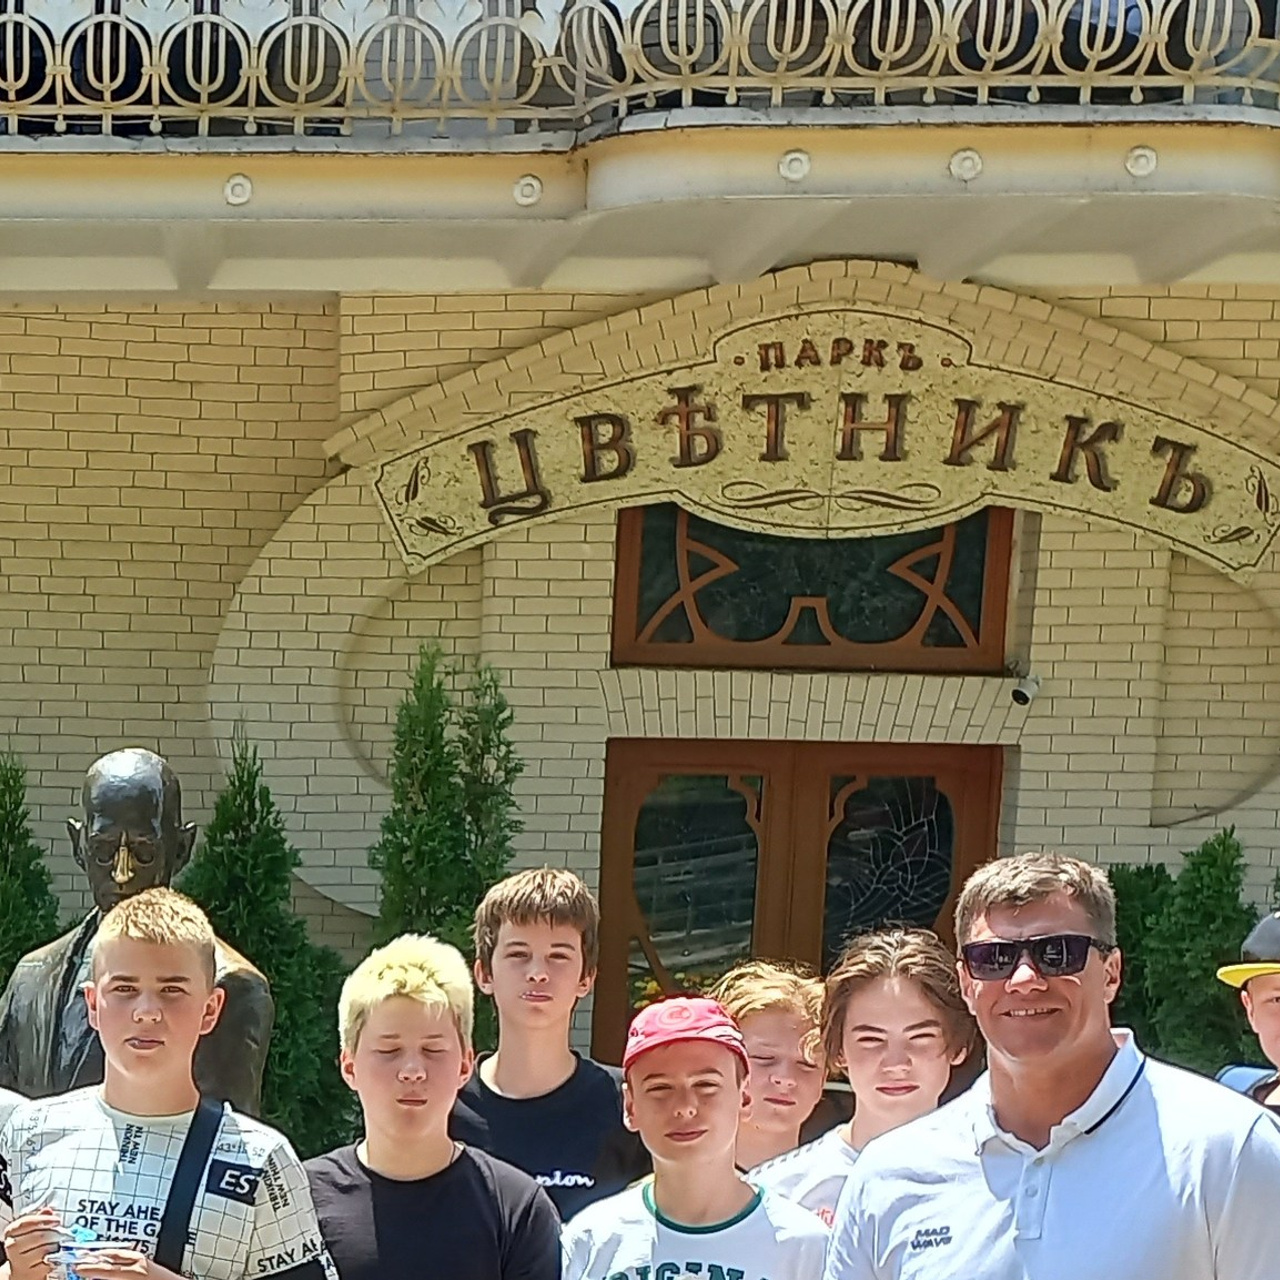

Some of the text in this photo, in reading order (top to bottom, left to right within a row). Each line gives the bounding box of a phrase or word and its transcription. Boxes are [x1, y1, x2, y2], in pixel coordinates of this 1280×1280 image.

[757, 337, 925, 372] ПАРКЪ
[127, 1139, 138, 1164] NEW
[77, 1199, 161, 1221] STAY AHE
[74, 1215, 99, 1232] OF
[105, 1218, 138, 1235] THE
[915, 1226, 951, 1240] MAD
[910, 1236, 952, 1251] WAVE
[257, 1248, 296, 1273] STAY
